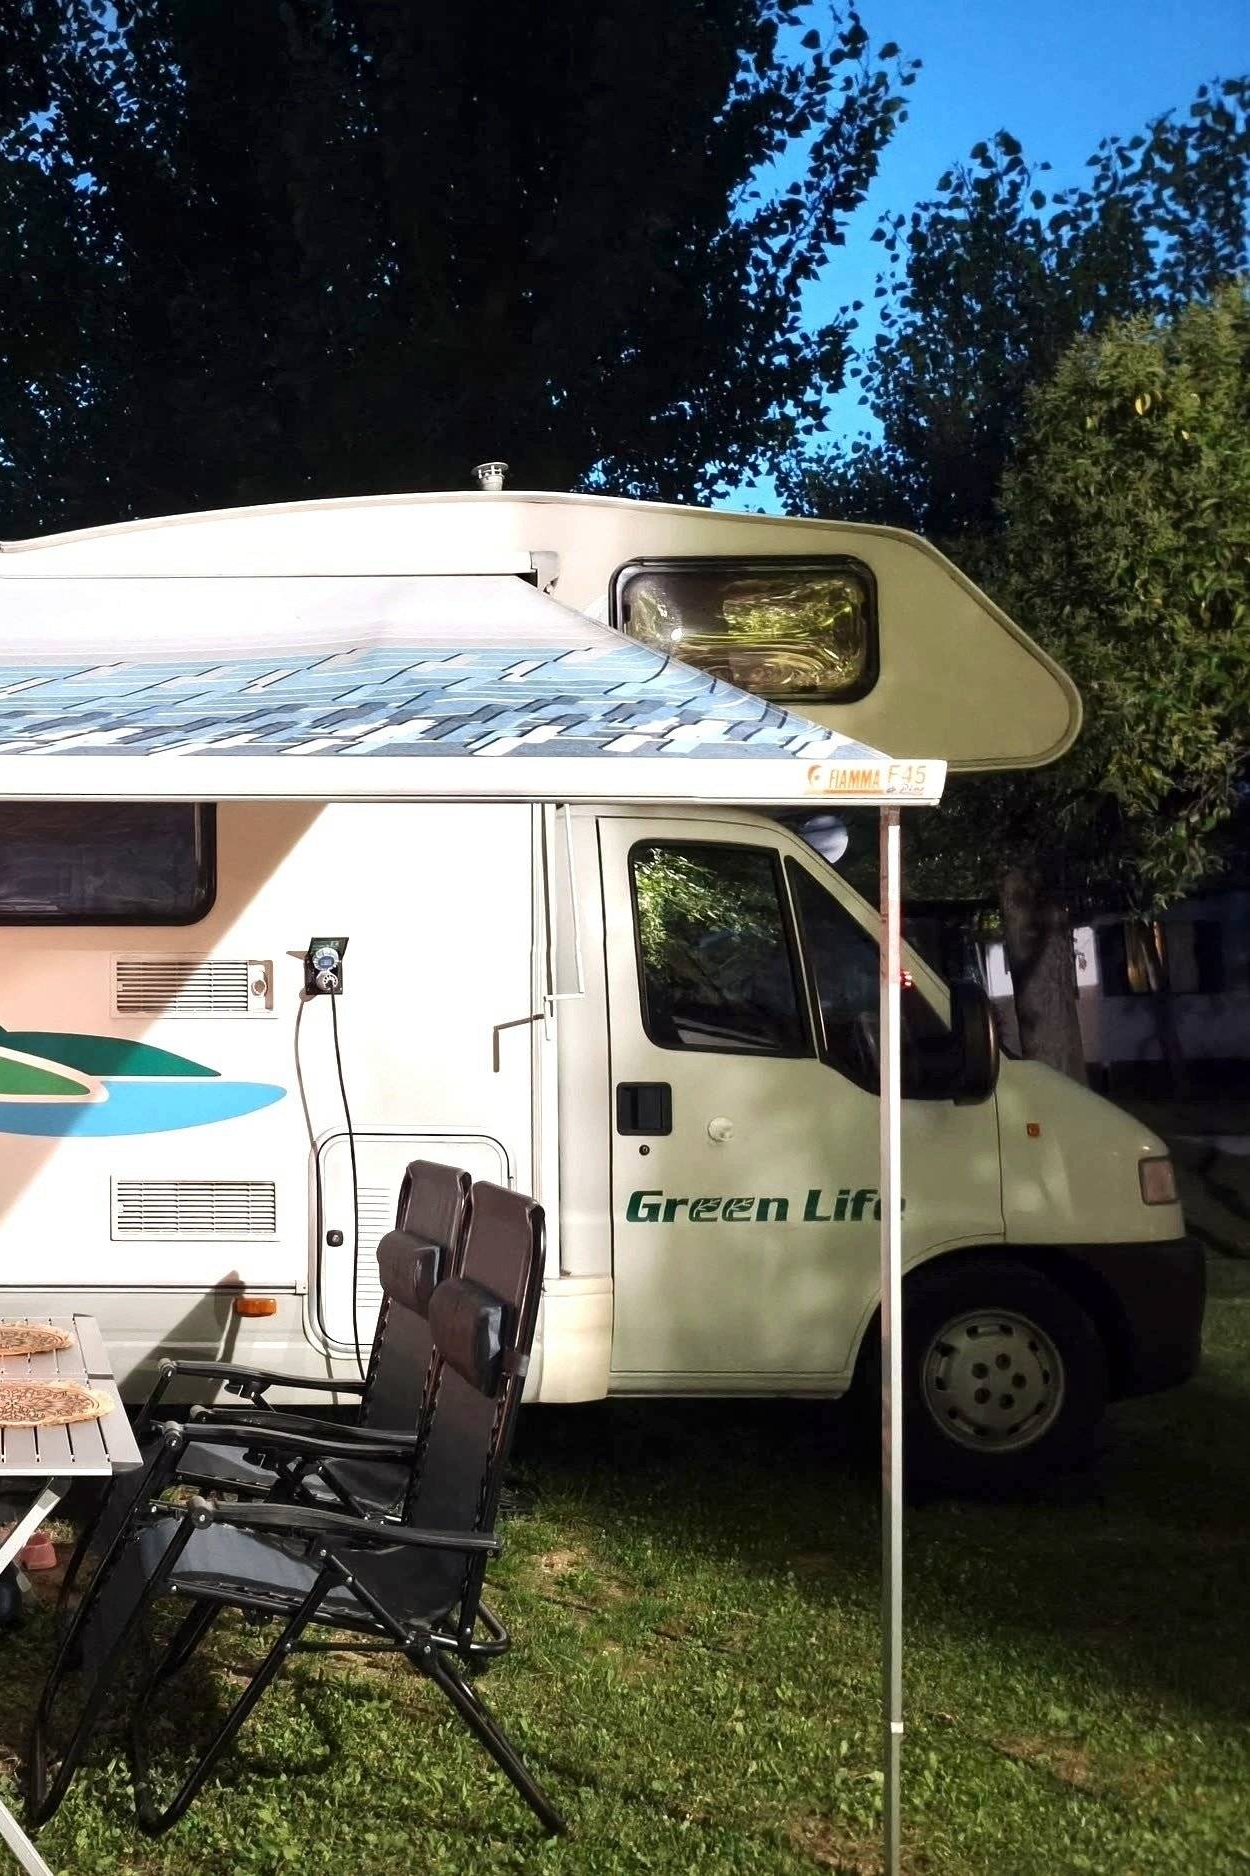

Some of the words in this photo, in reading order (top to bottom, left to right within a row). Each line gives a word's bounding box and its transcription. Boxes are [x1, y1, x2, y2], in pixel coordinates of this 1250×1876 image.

[829, 769, 881, 788] FIAMMA
[886, 764, 927, 784] F45
[625, 1190, 790, 1223] Green
